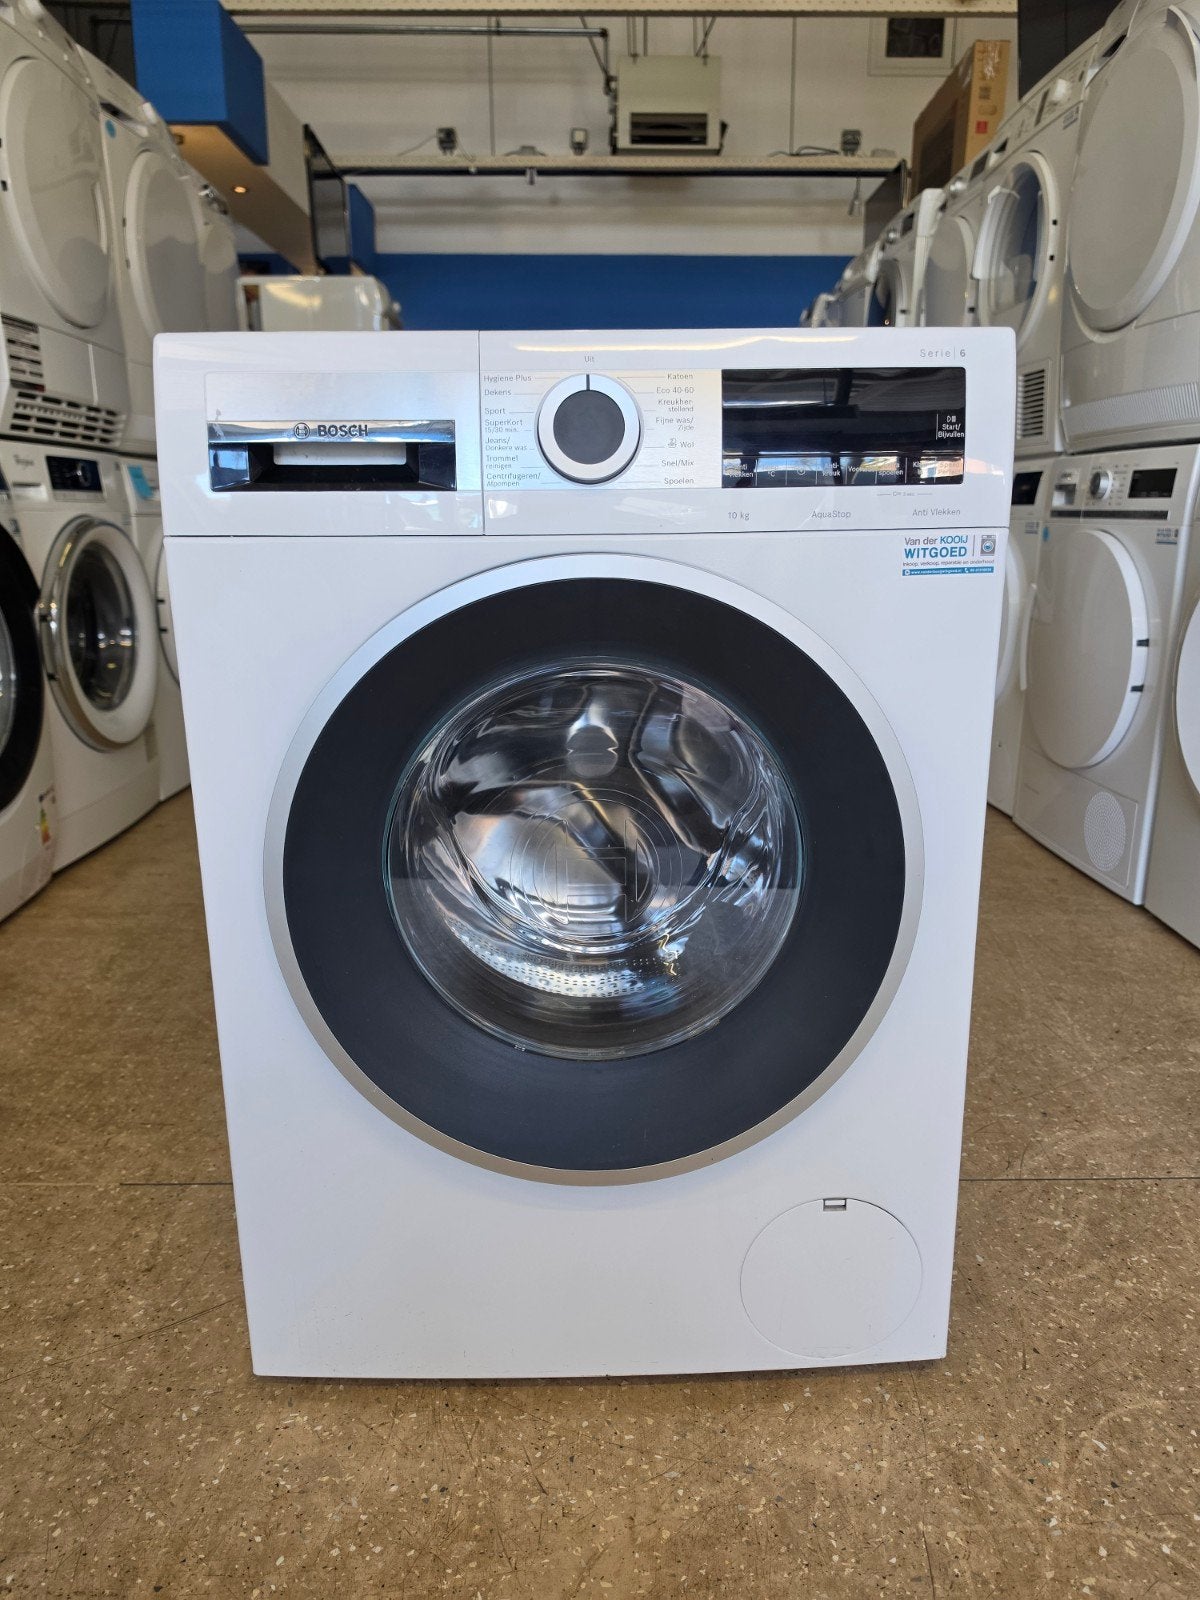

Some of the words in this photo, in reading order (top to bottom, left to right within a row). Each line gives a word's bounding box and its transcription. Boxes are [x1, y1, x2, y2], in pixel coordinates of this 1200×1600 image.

[919, 348, 951, 358] Serie
[959, 348, 966, 358] 6
[483, 375, 514, 383] Hygiene
[515, 374, 532, 382] Plus
[656, 386, 671, 394] Eco
[672, 386, 695, 394] 40-60
[484, 407, 506, 416] Sport
[484, 419, 523, 427] SuperKort
[655, 417, 674, 425] Fijne
[317, 424, 369, 437] BOSCH
[485, 426, 503, 434] 15/30
[942, 423, 961, 431] Start/
[937, 431, 965, 439] Bijvullen
[485, 436, 511, 445] Jeans/
[661, 459, 695, 467] Snel/Mix
[486, 472, 541, 481] Centrifugeren/
[664, 477, 695, 485] Spoelen
[727, 511, 738, 519] 10
[740, 511, 750, 521] kg
[811, 510, 852, 519] AquaStop
[912, 509, 928, 517] Anti
[930, 508, 961, 517] Vlekken
[904, 537, 921, 546] Van
[922, 536, 938, 545] der
[939, 534, 969, 545] KOOIJ
[904, 546, 967, 559] WITGOED
